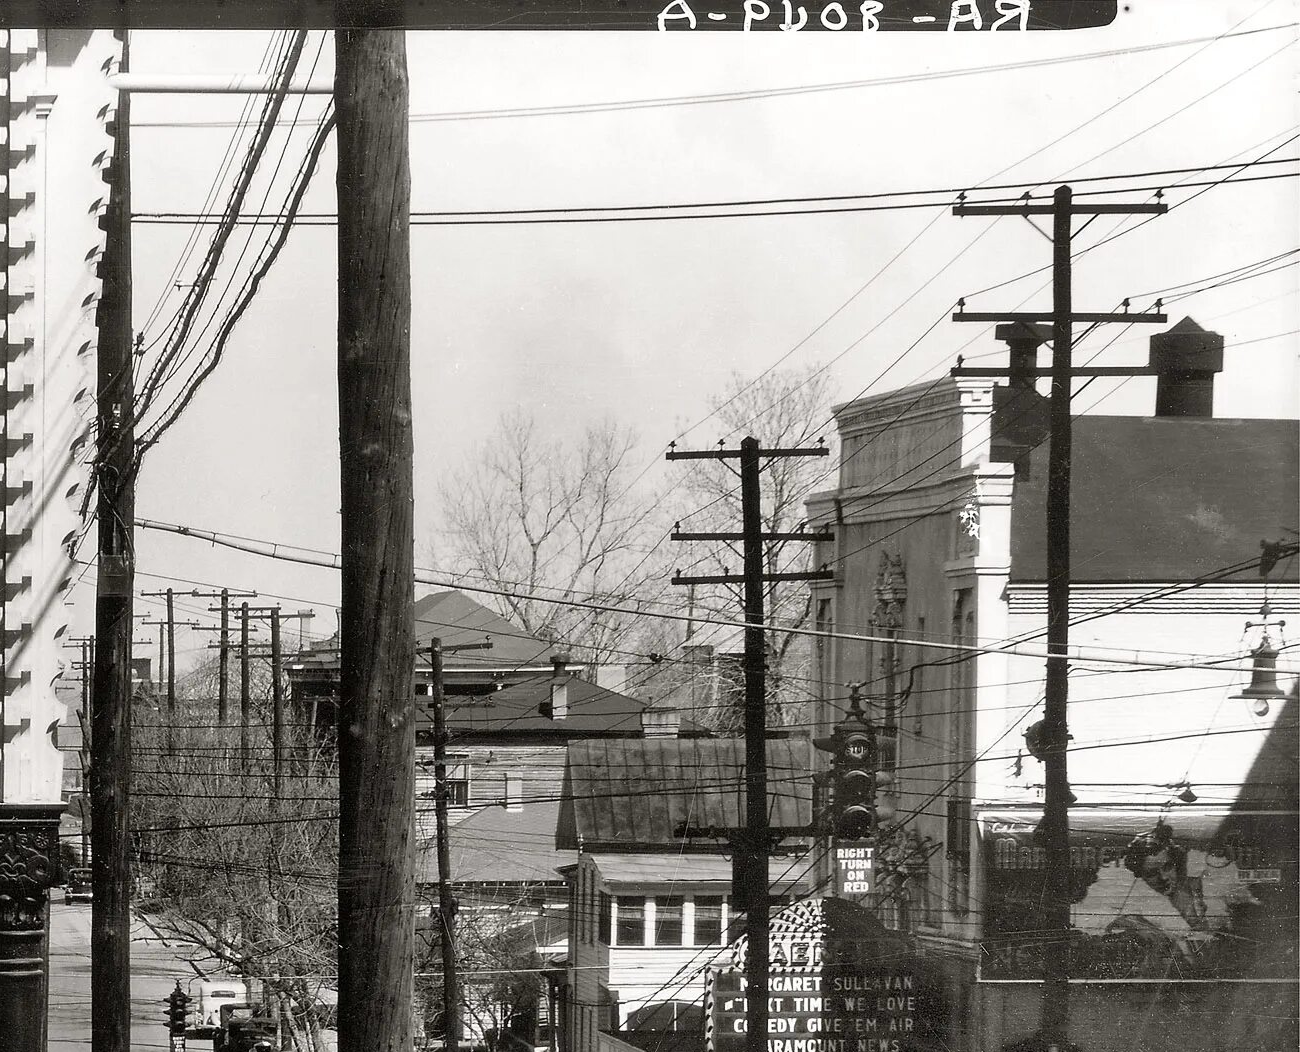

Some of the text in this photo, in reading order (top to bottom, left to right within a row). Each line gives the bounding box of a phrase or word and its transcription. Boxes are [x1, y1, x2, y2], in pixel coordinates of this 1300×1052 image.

[836, 848, 874, 858] RIGHT
[839, 859, 872, 869] TURN
[847, 870, 865, 880] ON
[843, 881, 869, 893] RED
[739, 977, 822, 992] MGARET
[793, 997, 832, 1012] TIME
[844, 997, 866, 1011] WE
[733, 1018, 797, 1033] CEDY
[807, 1018, 842, 1033] GIVE
[889, 1018, 914, 1032] AIR
[858, 1039, 900, 1052] NEWS
